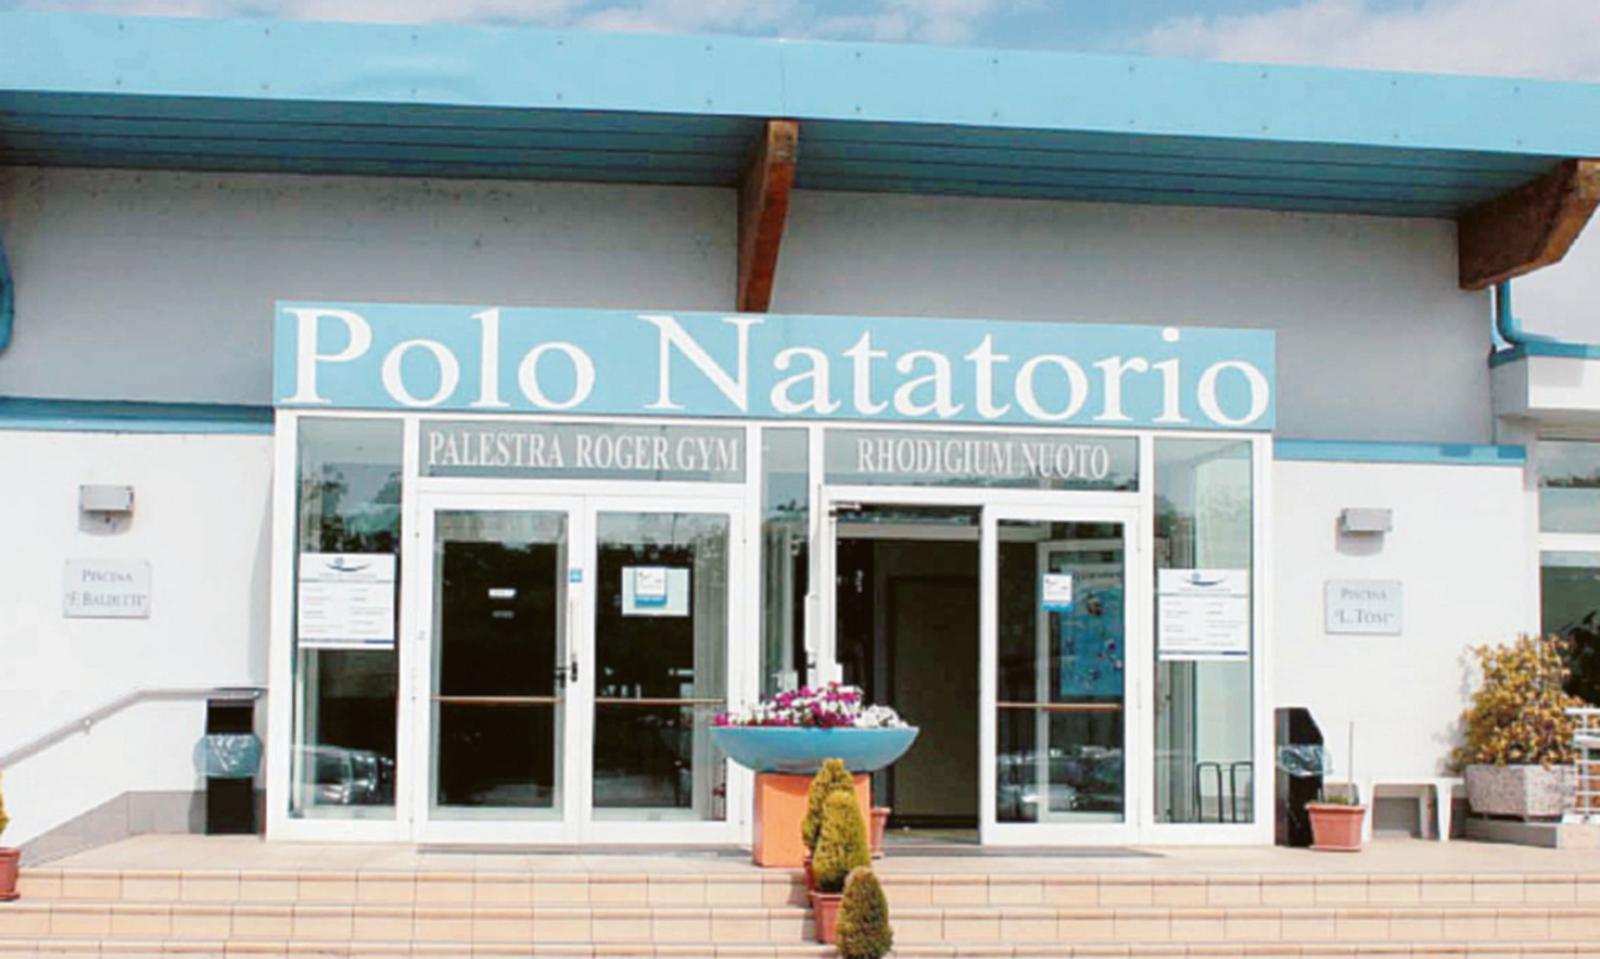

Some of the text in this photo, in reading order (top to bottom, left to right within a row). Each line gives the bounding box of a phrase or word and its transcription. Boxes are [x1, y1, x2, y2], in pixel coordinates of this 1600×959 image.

[279, 306, 1270, 428] Polo Natatorio
[428, 430, 739, 474] PALESTRA ROGER GYM
[857, 437, 1109, 480] RHODIGIUM NUOTO
